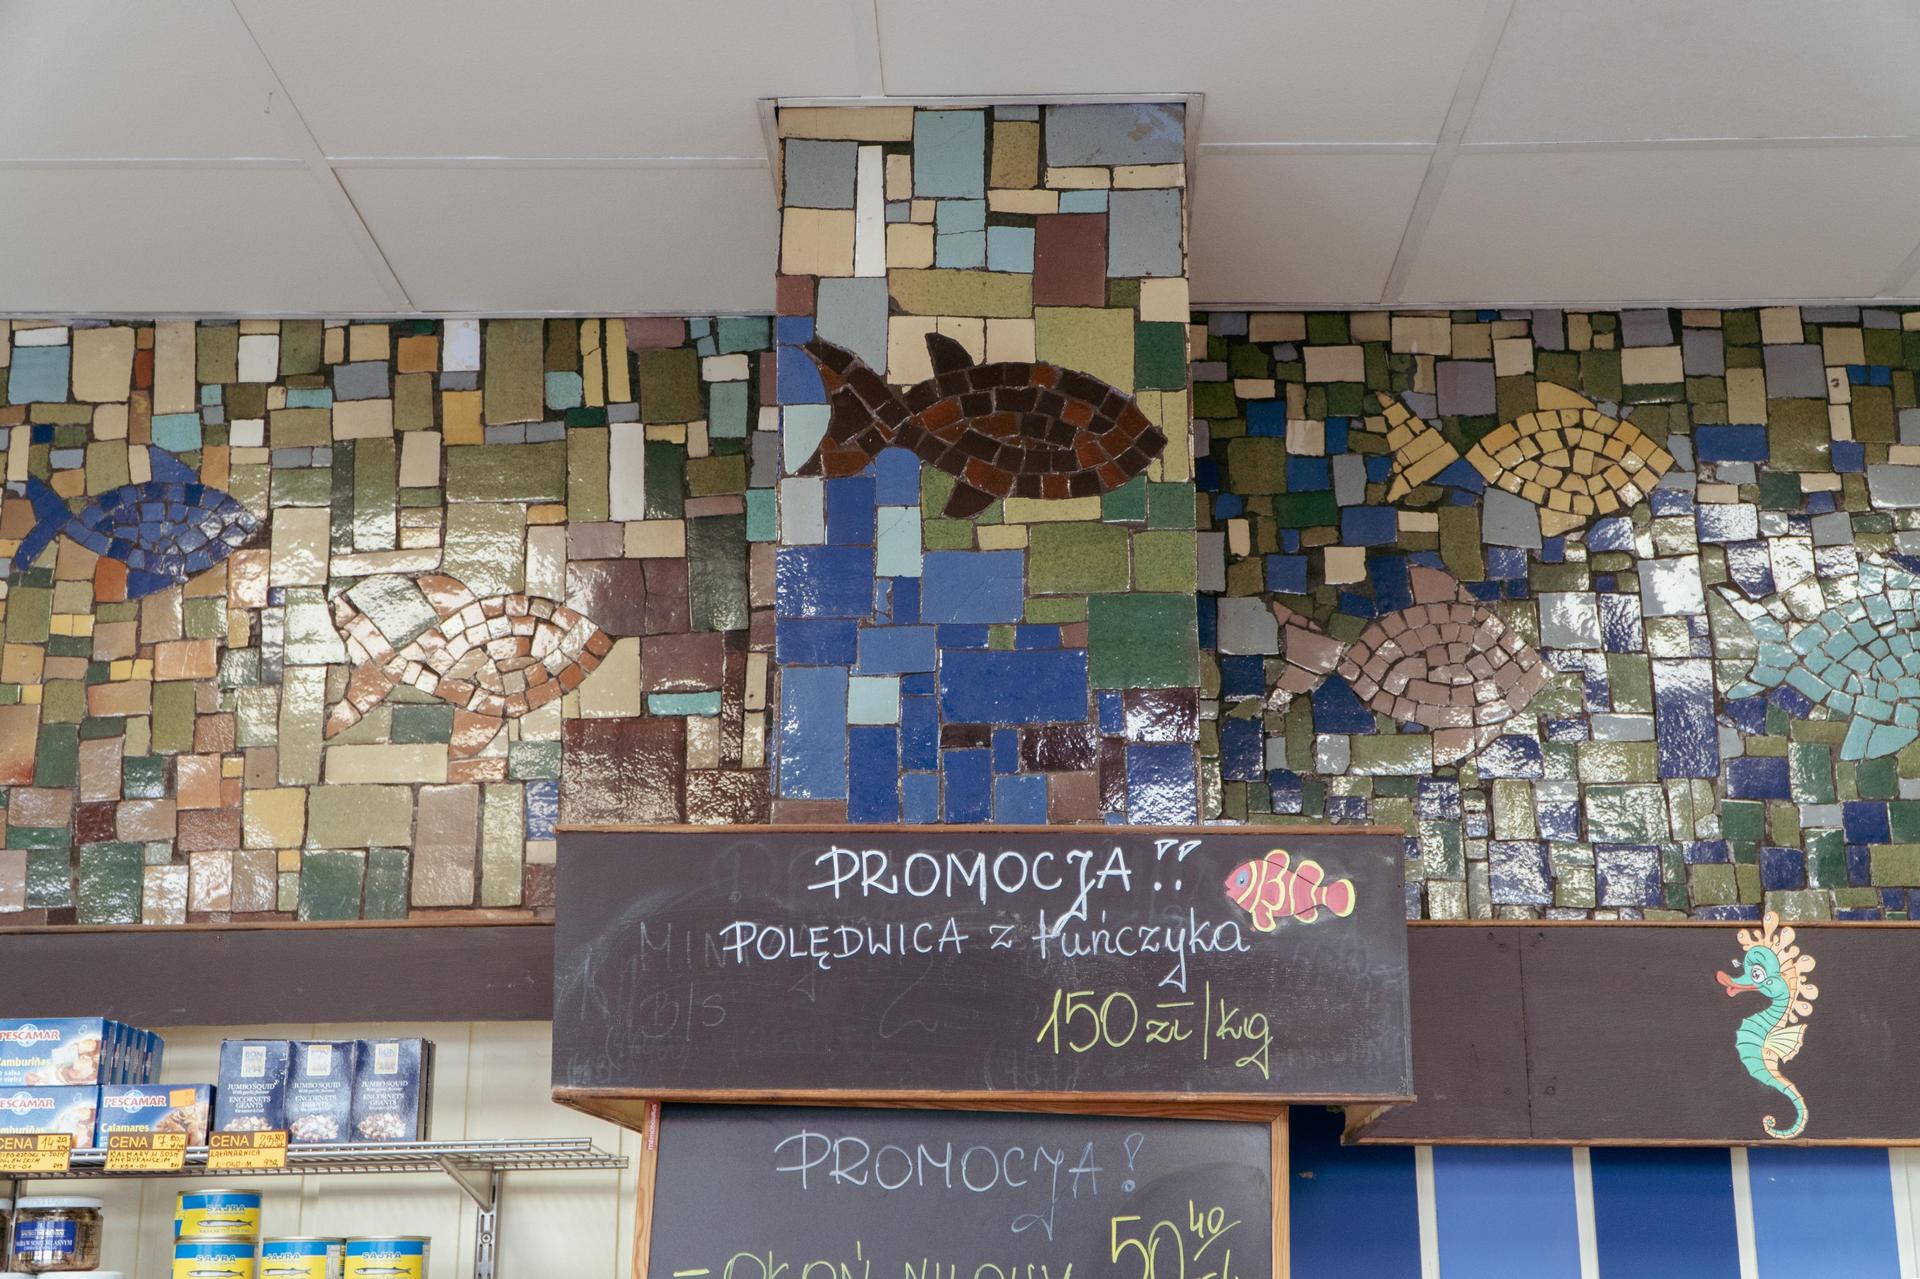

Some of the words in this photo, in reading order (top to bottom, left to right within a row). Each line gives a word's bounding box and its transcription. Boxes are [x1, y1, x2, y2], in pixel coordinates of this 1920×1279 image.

[807, 846, 1132, 936] PROMOCJA
[719, 920, 968, 970] POLĘDWICA
[1035, 987, 1139, 1055] 150
[0, 1030, 60, 1040] PESCAMAR
[0, 1056, 49, 1068] amburiñas
[252, 1083, 275, 1091] SQUID
[293, 1081, 317, 1089] JUMBO
[319, 1081, 341, 1090] SQUID
[361, 1080, 385, 1088] JUMBO
[385, 1080, 409, 1088] SQUID
[0, 1099, 53, 1109] ESCAMAR
[103, 1095, 166, 1107] PESCAMAR
[100, 1123, 150, 1133] Calamares
[109, 1135, 149, 1148] CENA
[210, 1135, 250, 1148] CENA
[207, 1203, 246, 1212] SAJRA
[195, 1254, 237, 1262] SAJRA
[265, 1252, 301, 1260] SAJRA
[361, 1251, 402, 1260] SAJRA
